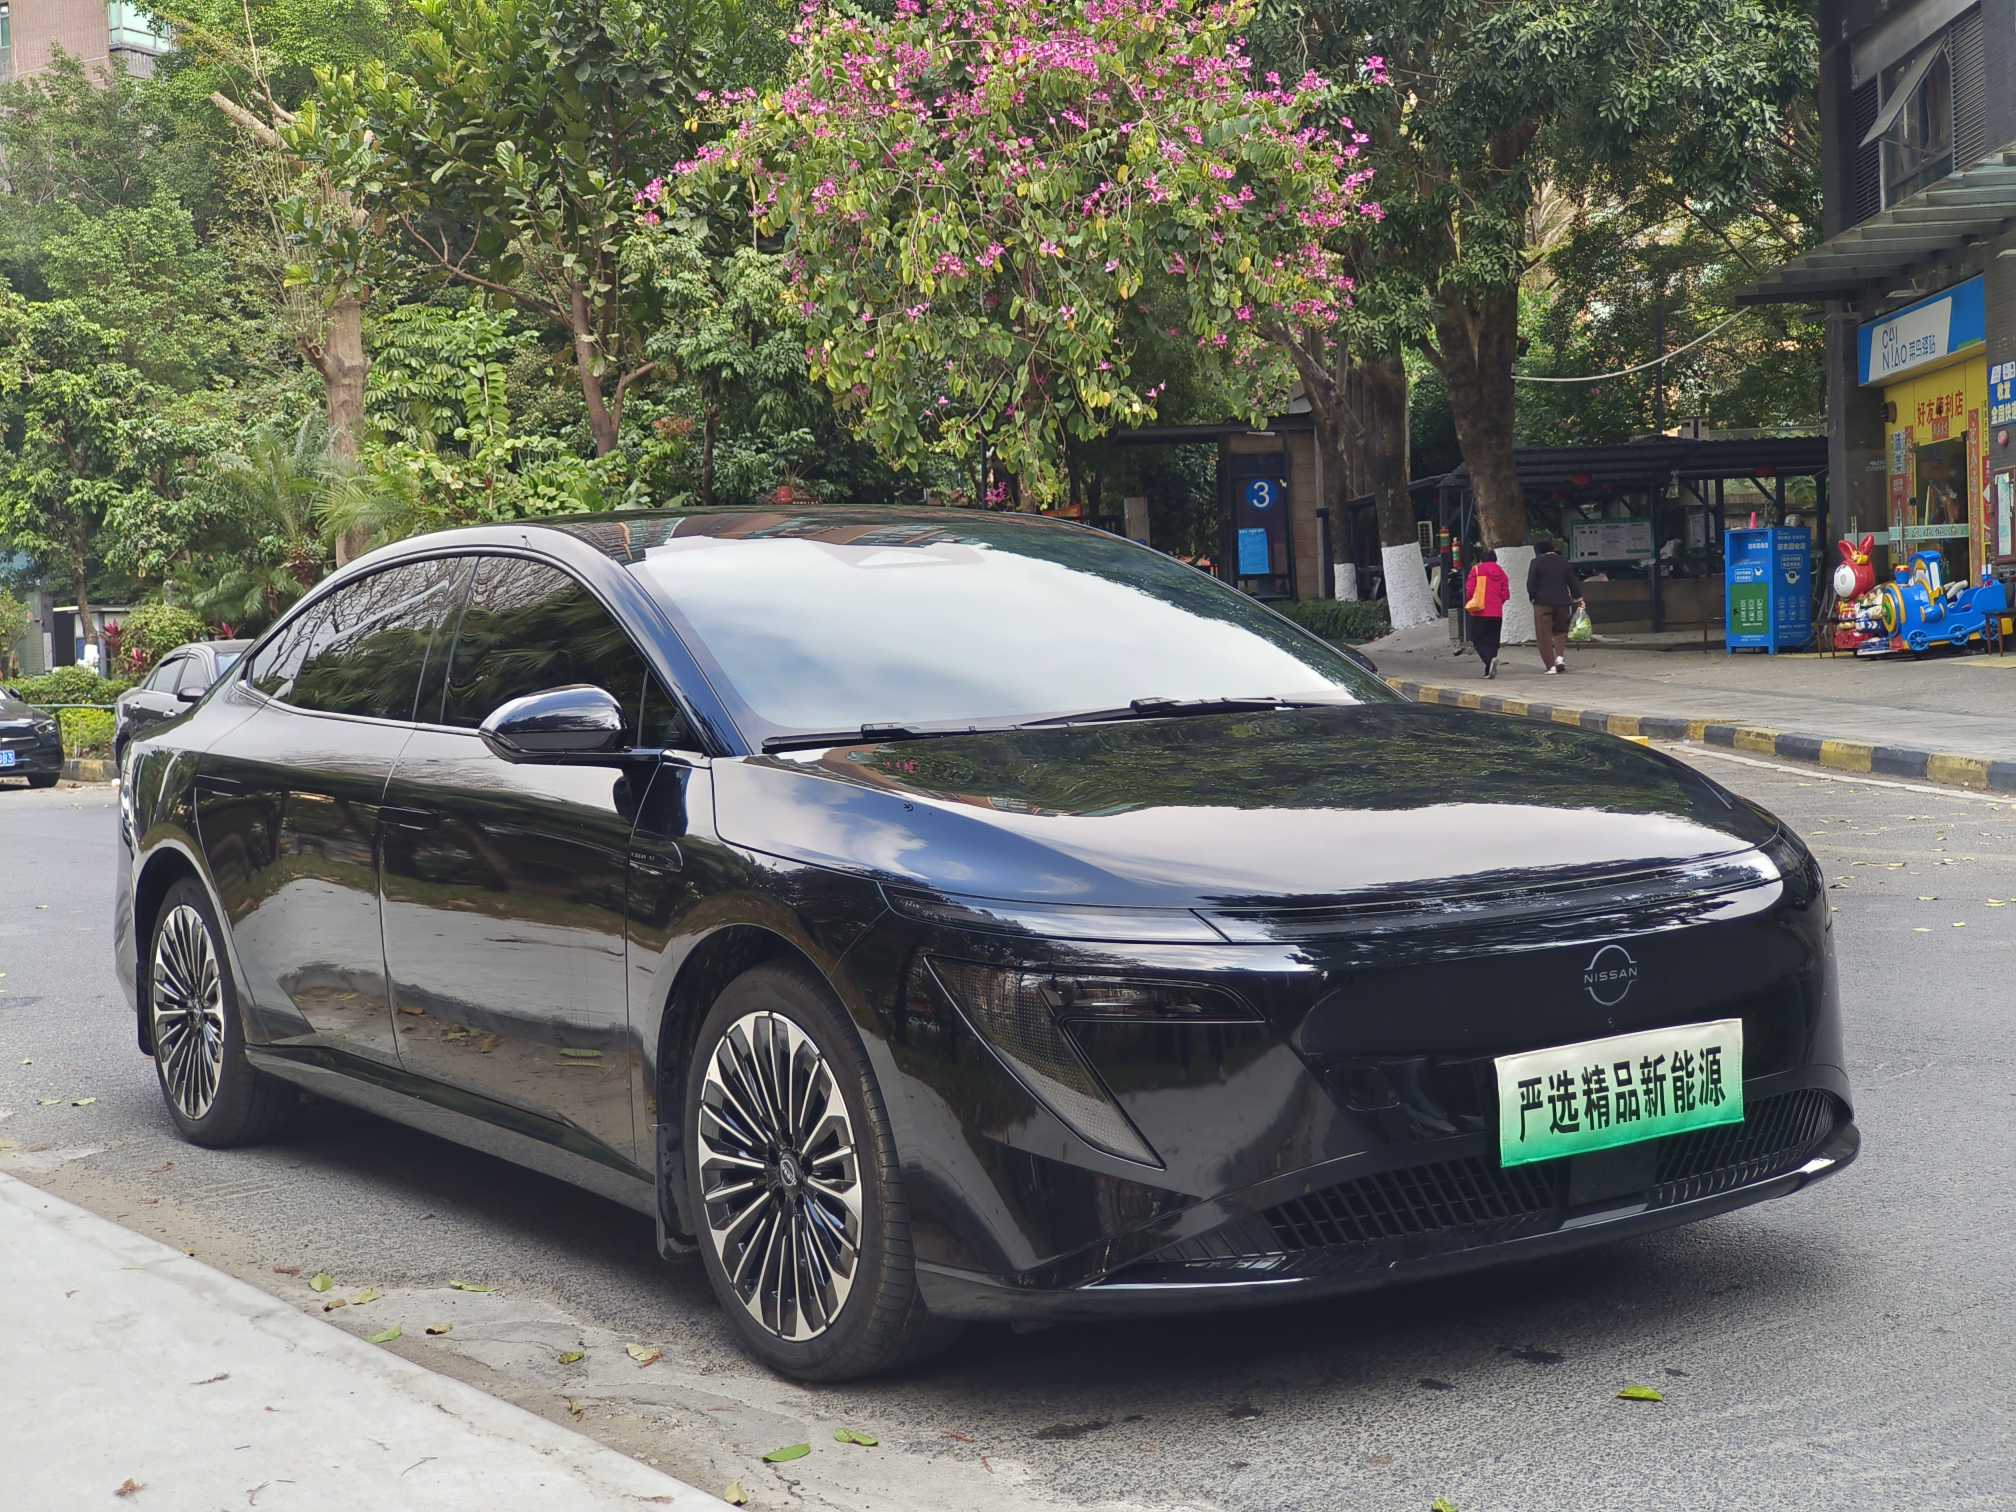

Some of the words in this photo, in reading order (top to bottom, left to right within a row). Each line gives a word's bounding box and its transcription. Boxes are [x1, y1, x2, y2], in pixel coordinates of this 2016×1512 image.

[1252, 481, 1270, 508] 3
[1584, 967, 1638, 984] NISSAN
[1517, 1045, 1726, 1143] 严选精品新能源
